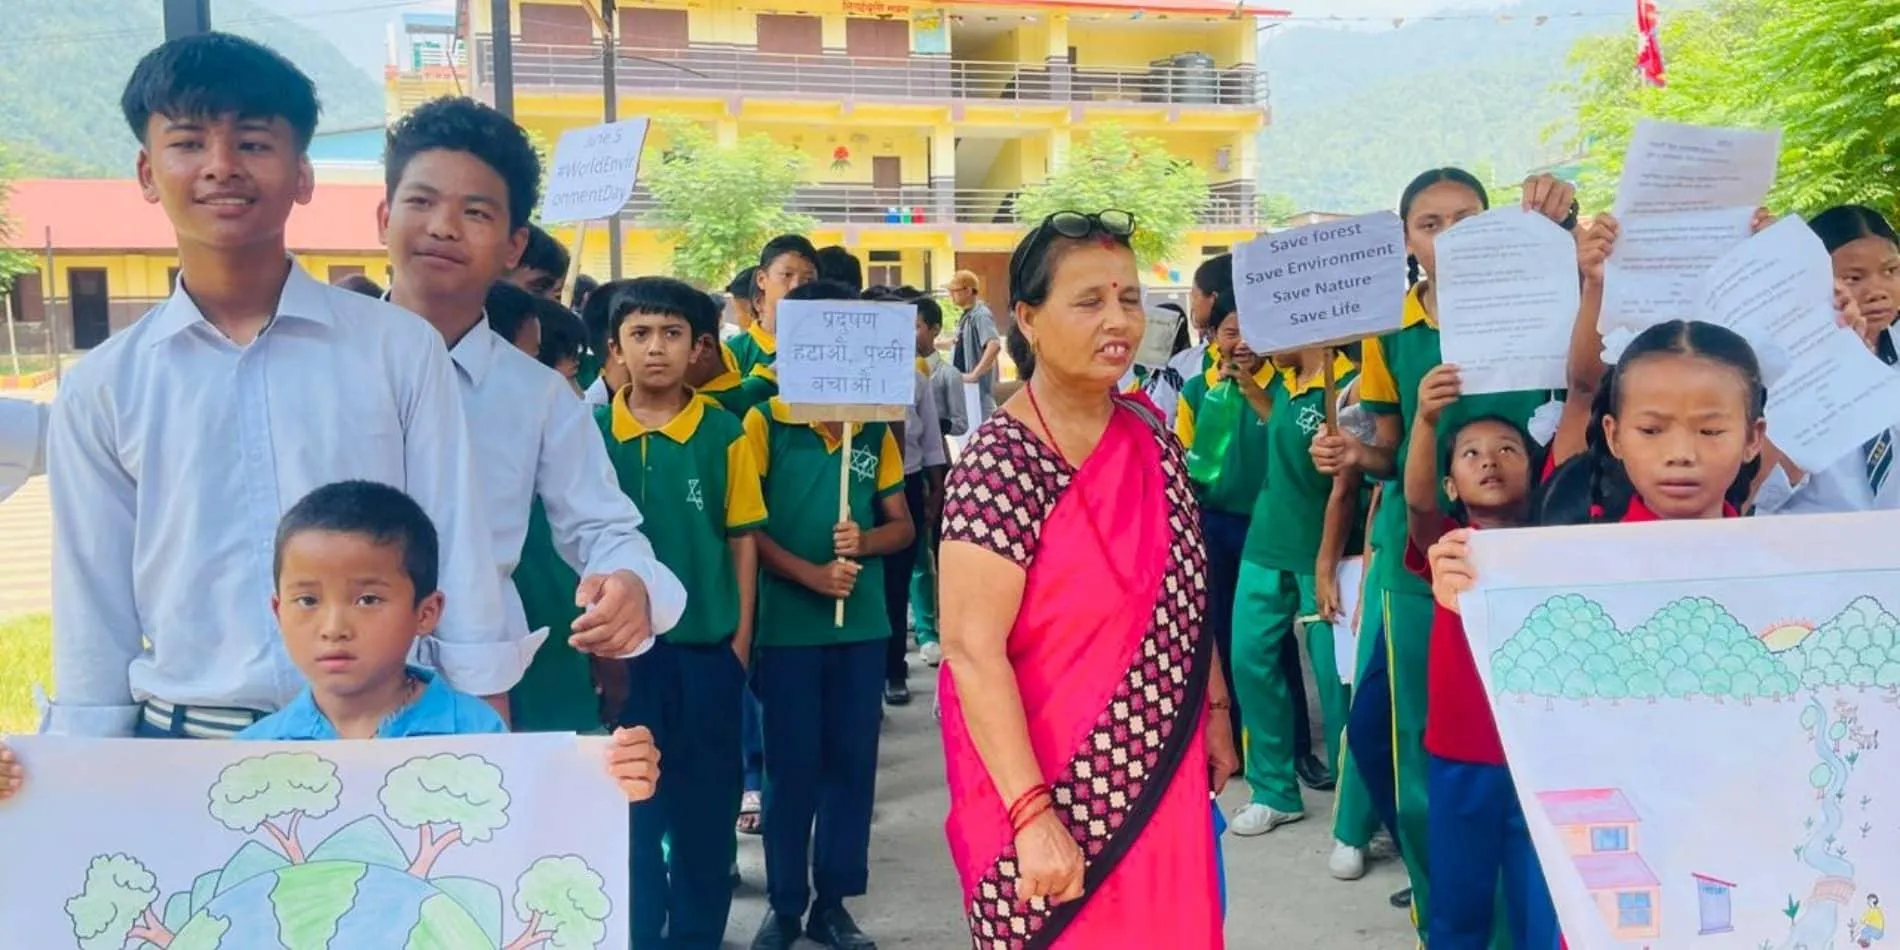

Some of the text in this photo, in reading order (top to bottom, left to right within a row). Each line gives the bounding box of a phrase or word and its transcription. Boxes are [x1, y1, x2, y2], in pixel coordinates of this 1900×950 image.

[552, 184, 624, 209] onmentDay
[1269, 223, 1362, 254] Save forest
[1245, 243, 1396, 285] Save Environment
[1272, 274, 1373, 305] Save Nature
[1289, 301, 1361, 326] Save Life
